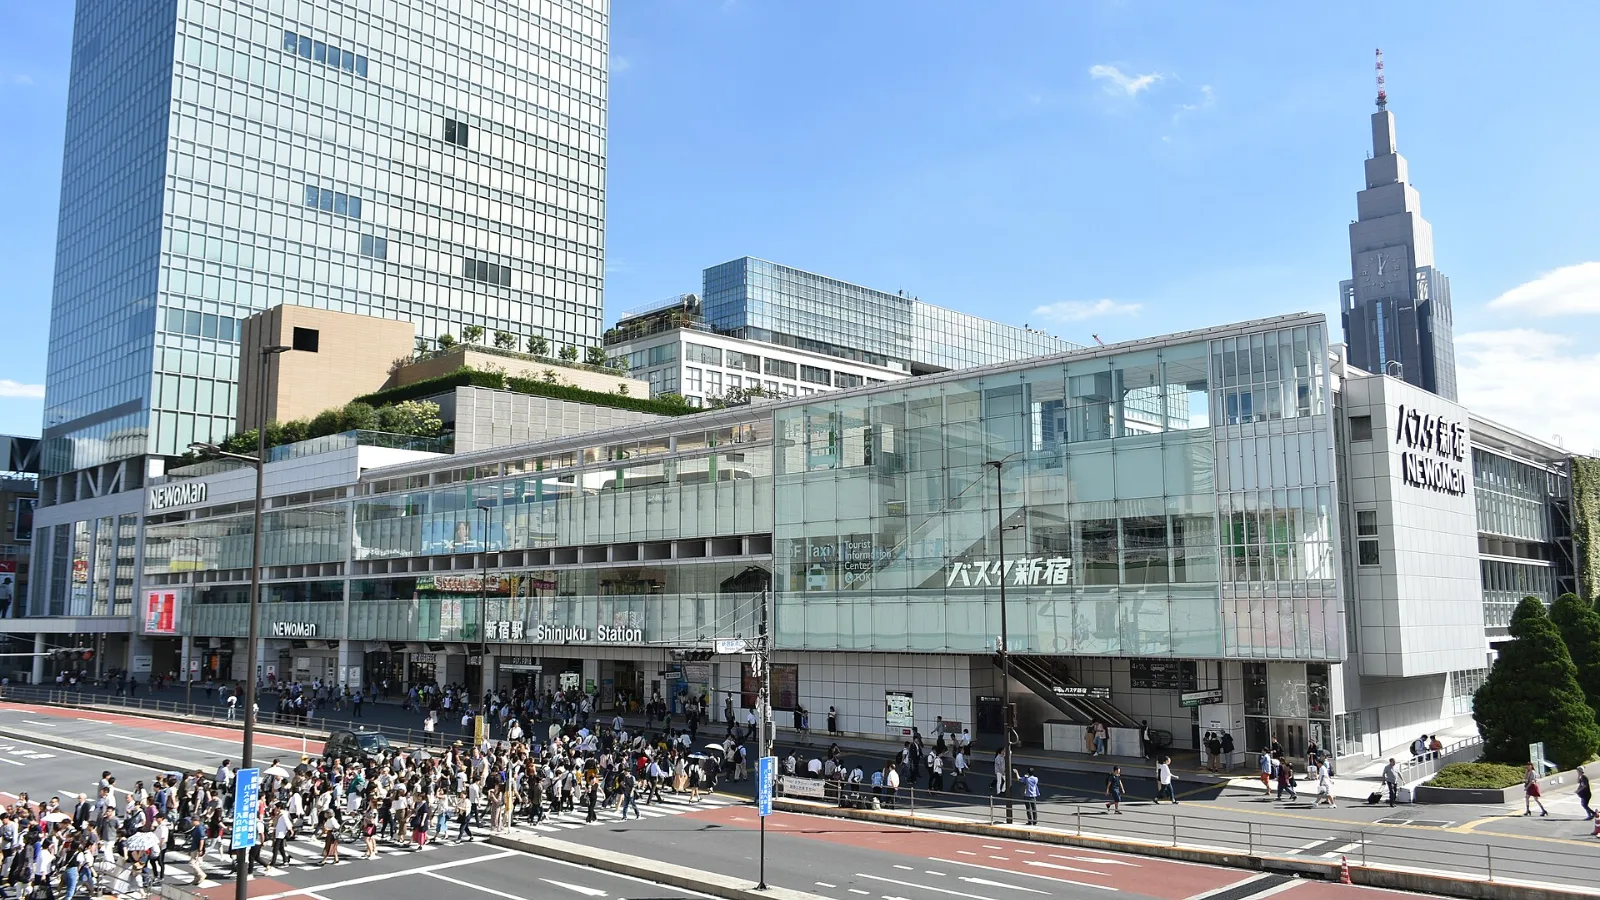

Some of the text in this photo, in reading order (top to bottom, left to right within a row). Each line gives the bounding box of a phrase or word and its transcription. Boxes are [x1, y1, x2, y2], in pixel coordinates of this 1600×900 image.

[1397, 404, 1466, 461] バスタ新宿
[1403, 452, 1466, 495] NEWoMan
[150, 482, 207, 510] NEWoMan
[845, 540, 871, 549] Tourist
[844, 561, 872, 570] Center
[946, 556, 1071, 587] バスタ新宿
[272, 621, 316, 637] NEWoMan
[485, 620, 524, 640] 新宿駅
[537, 624, 642, 645] Shinjuku Station
